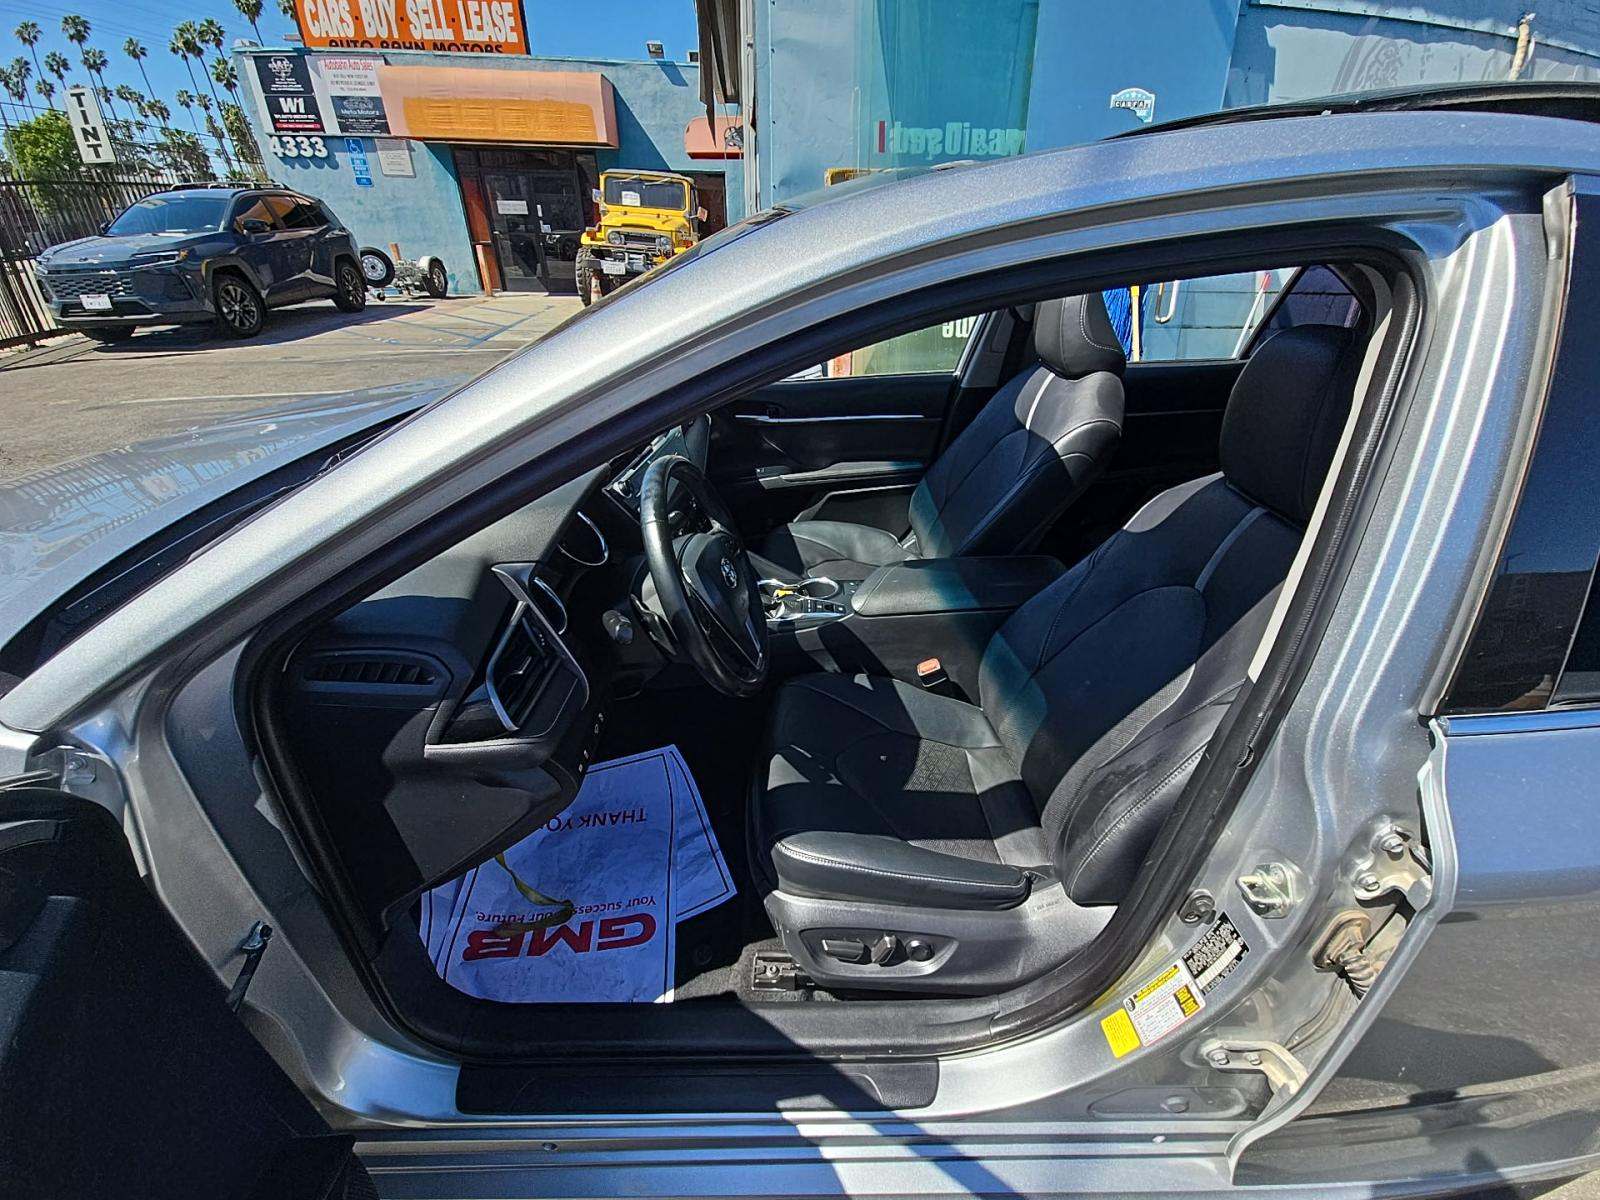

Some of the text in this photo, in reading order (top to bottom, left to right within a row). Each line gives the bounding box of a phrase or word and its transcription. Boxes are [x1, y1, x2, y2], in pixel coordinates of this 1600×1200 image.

[304, 0, 518, 43] CARS BUY SELL LEASE
[1114, 100, 1148, 109] CARFA
[70, 92, 103, 159] TINT
[270, 136, 328, 158] 4333
[542, 807, 647, 832] THANK YO
[626, 896, 657, 909] Your
[462, 912, 657, 962] GMB
